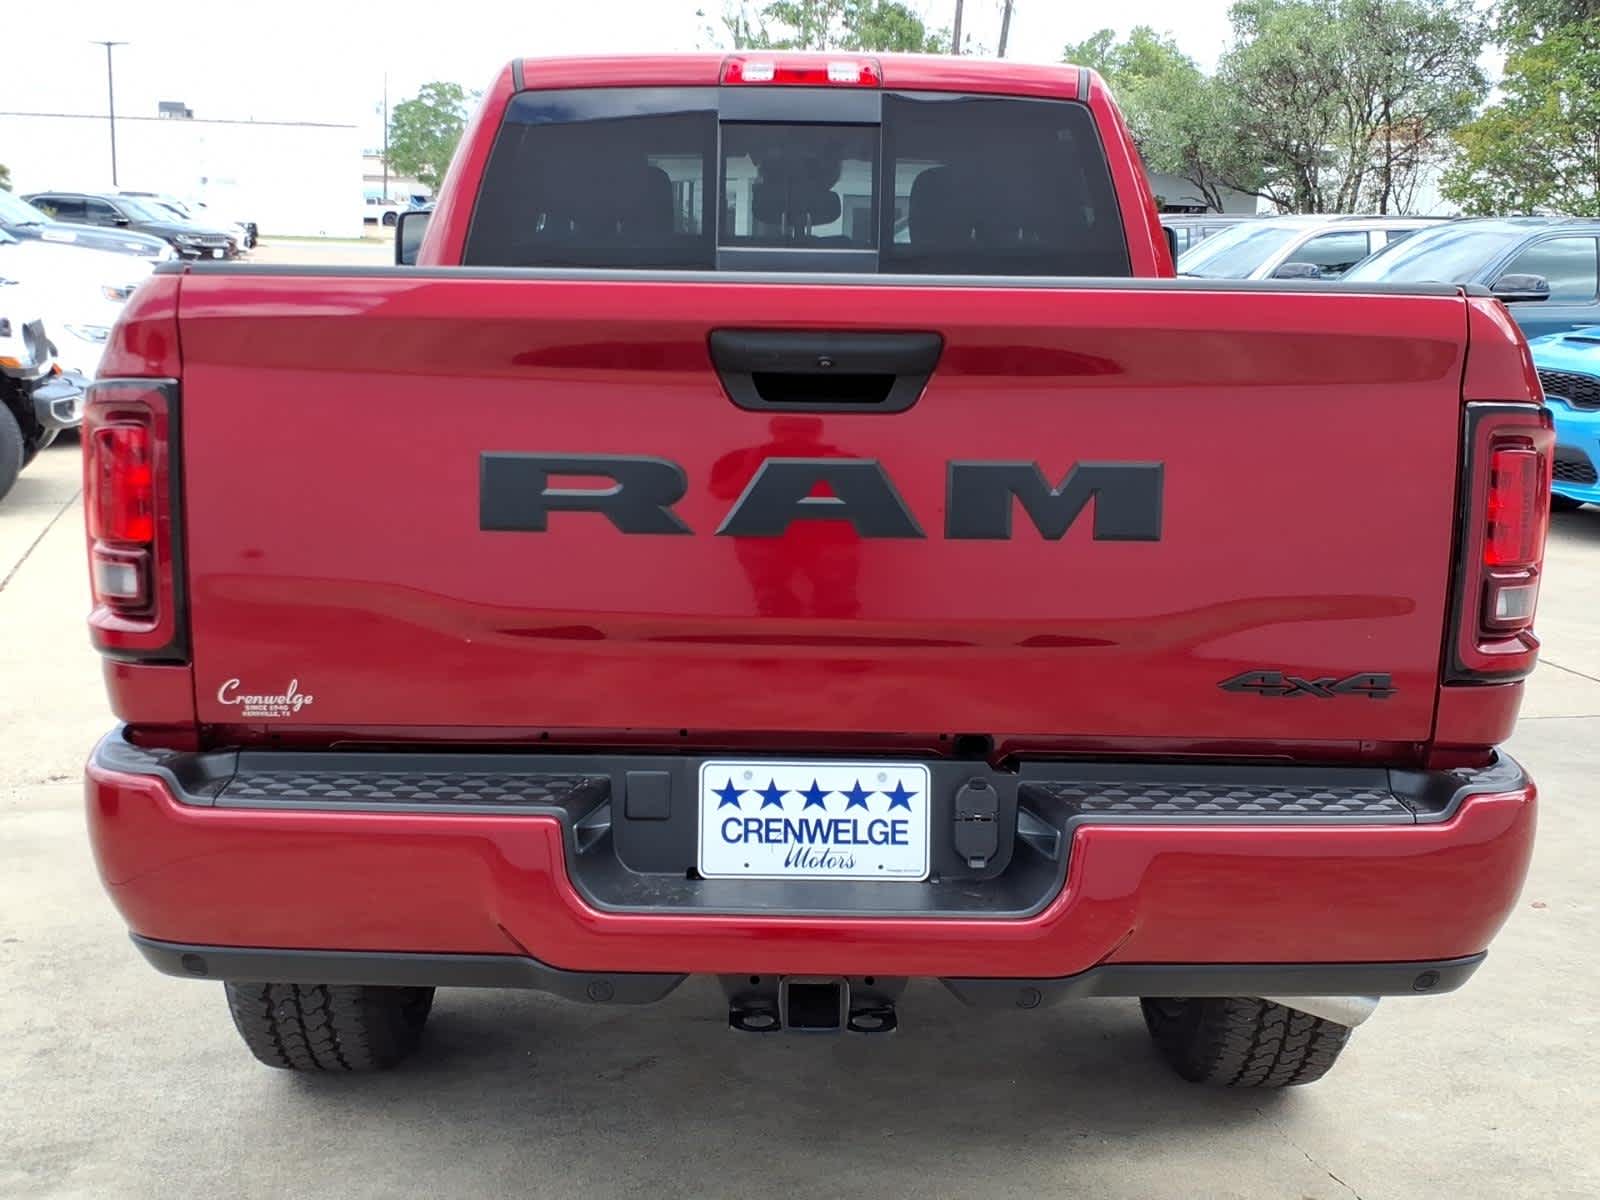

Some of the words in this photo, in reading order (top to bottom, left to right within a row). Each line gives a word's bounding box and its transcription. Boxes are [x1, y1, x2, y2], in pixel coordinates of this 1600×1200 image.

[479, 450, 1165, 542] RAM
[217, 678, 313, 712] Crenwelge
[721, 817, 909, 846] CRENWELGE
[784, 842, 856, 869] Motors
